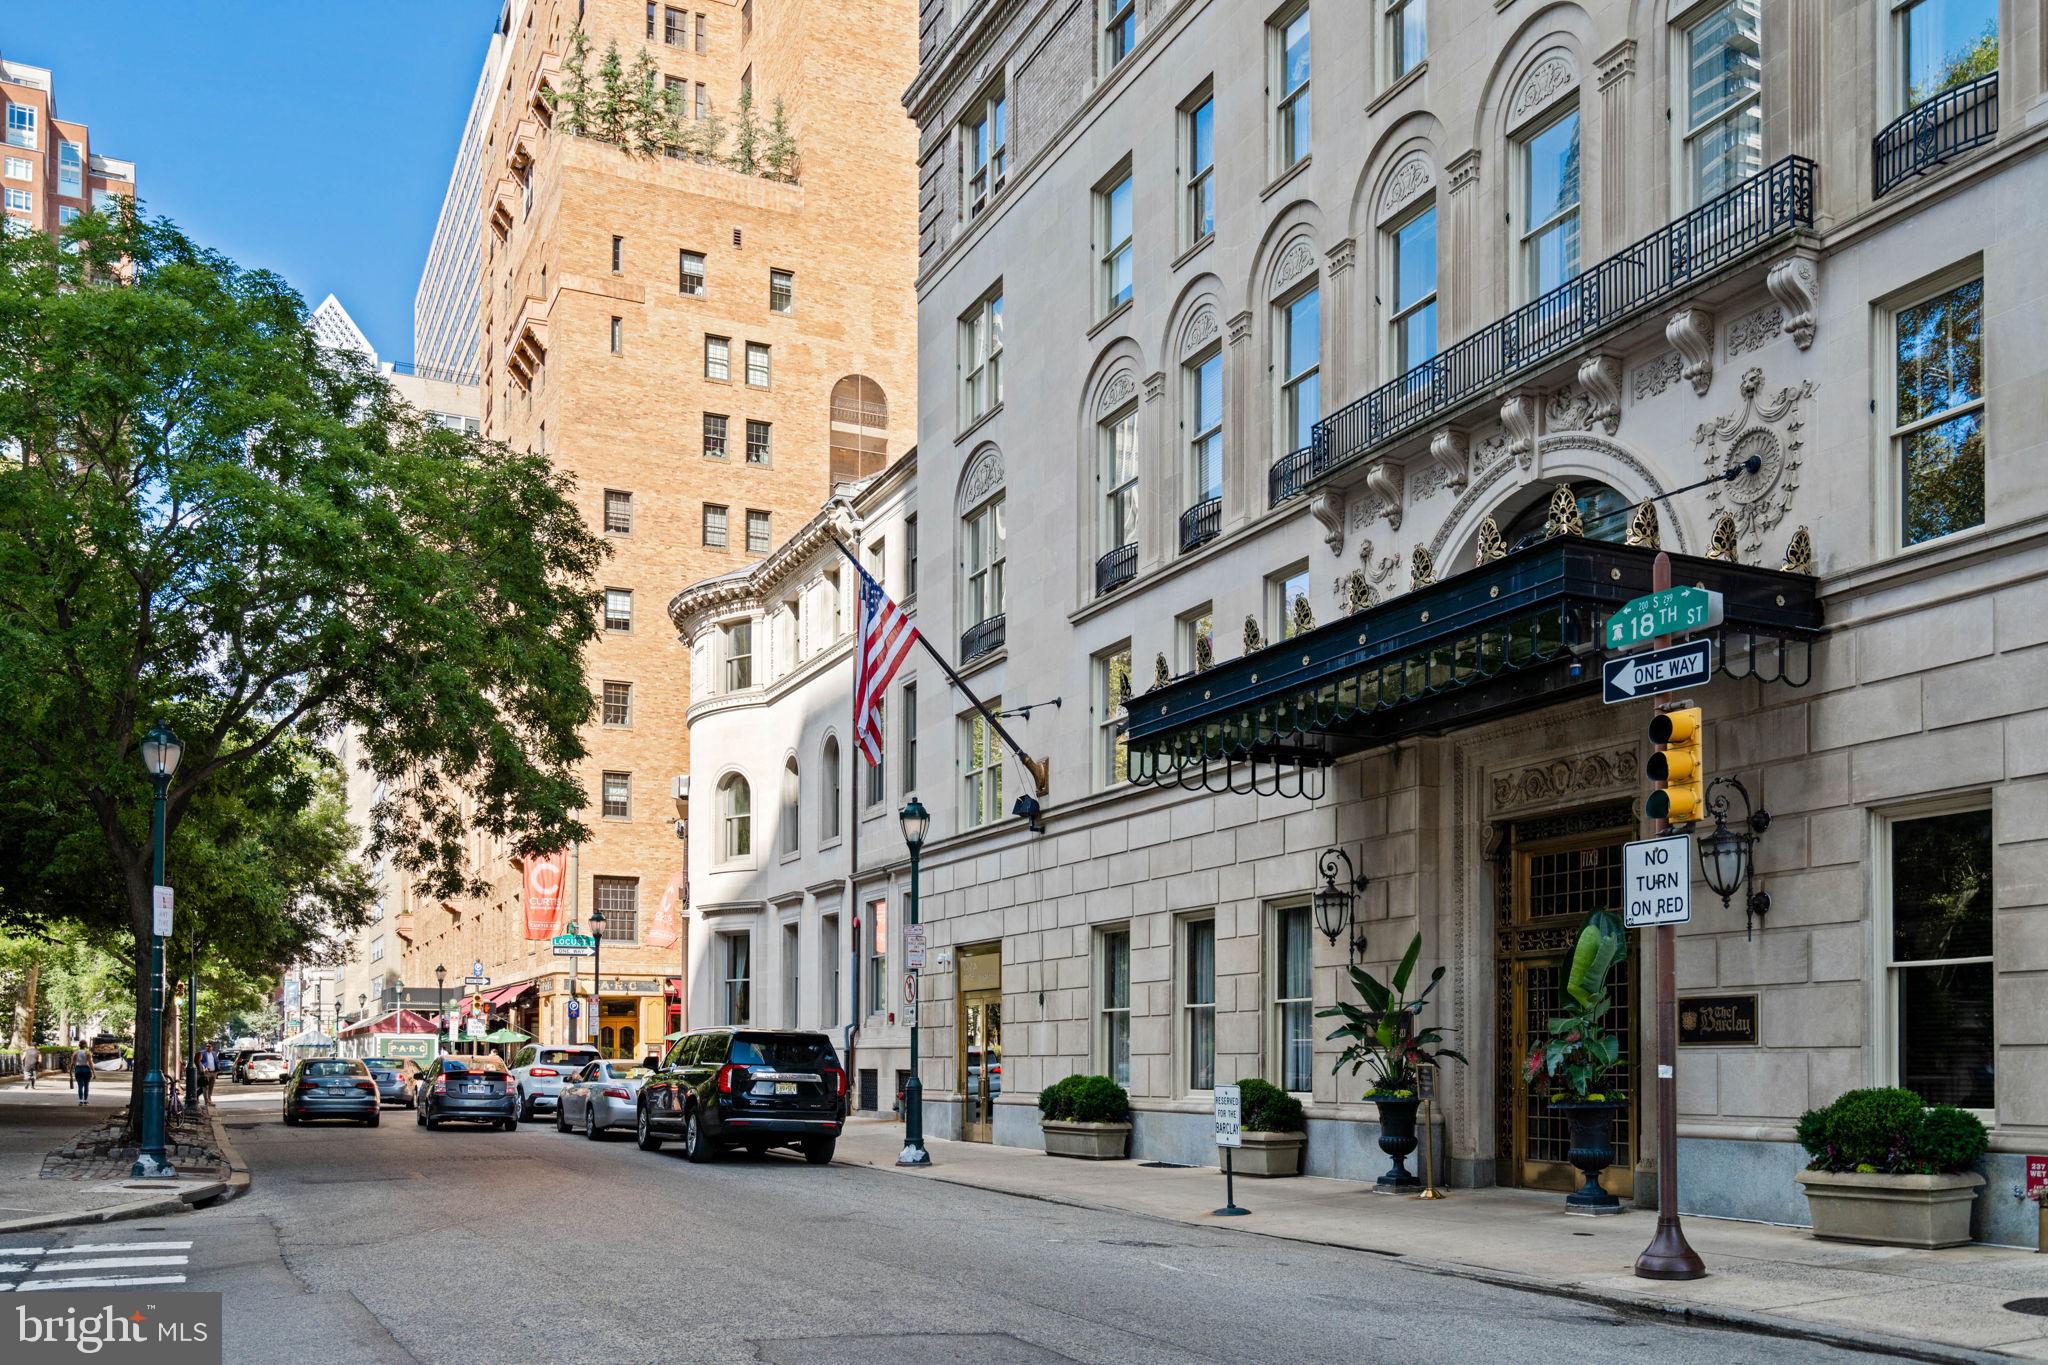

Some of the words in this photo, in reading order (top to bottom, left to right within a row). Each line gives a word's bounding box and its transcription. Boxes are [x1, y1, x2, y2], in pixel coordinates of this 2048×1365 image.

[1638, 600, 1649, 611] 200
[1653, 596, 1659, 609] S
[1663, 593, 1674, 604] 299
[1687, 605, 1703, 625] ST
[1634, 663, 1664, 684] ONE
[1669, 655, 1698, 677] WAY
[1645, 848, 1668, 866] NO
[1636, 872, 1678, 891] TURN
[529, 897, 561, 907] CURTIS
[1631, 900, 1651, 917] ON
[1657, 896, 1684, 914] RED
[1699, 1005, 1750, 1035] Barclay
[1714, 1006, 1732, 1019] The
[1215, 1097, 1239, 1105] RESERVED
[1217, 1109, 1226, 1118] FOR
[1228, 1110, 1237, 1118] THE
[1215, 1122, 1240, 1135] BARCLAY
[2030, 1170, 2047, 1178] WET
